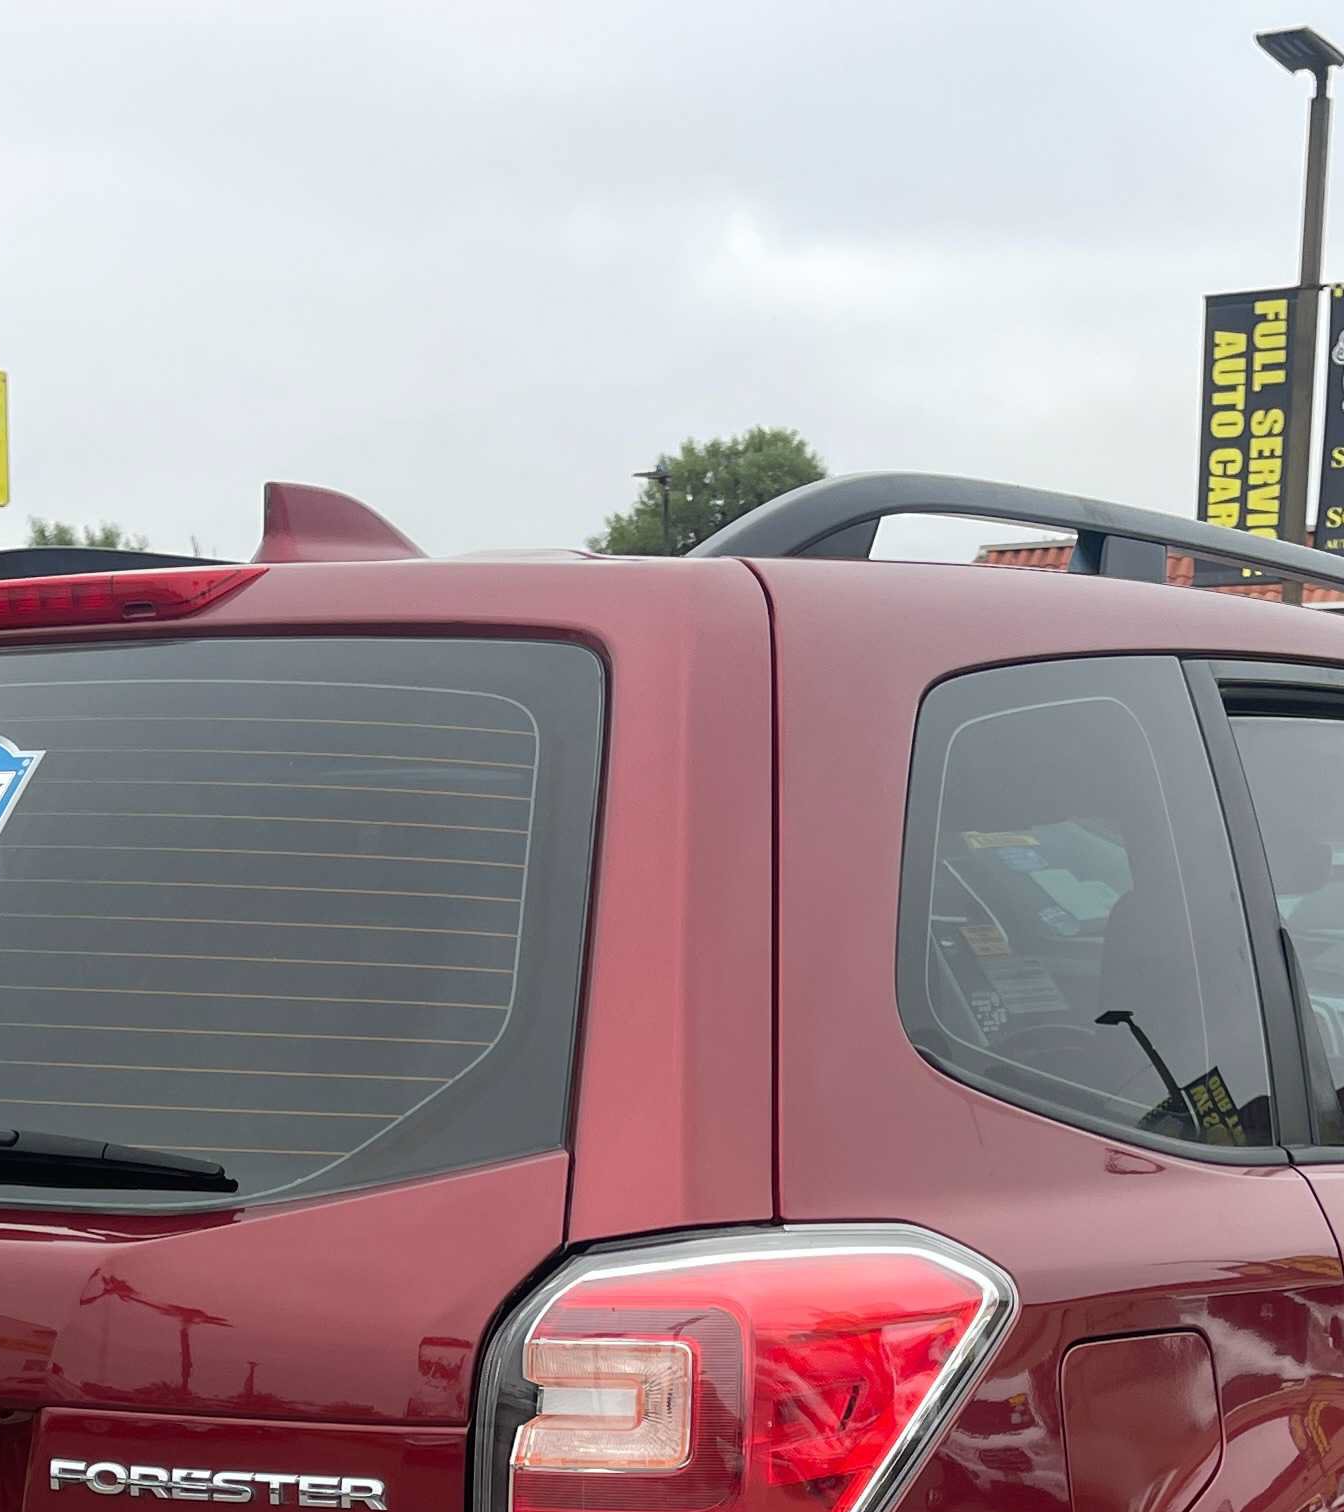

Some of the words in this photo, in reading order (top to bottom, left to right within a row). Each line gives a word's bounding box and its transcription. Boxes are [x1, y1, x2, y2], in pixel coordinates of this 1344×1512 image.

[1210, 330, 1248, 439] AUTO
[1252, 298, 1288, 392] FULL
[1206, 447, 1244, 529] CAR
[1246, 408, 1285, 540] SERVI
[49, 1457, 389, 1511] FORESTER
